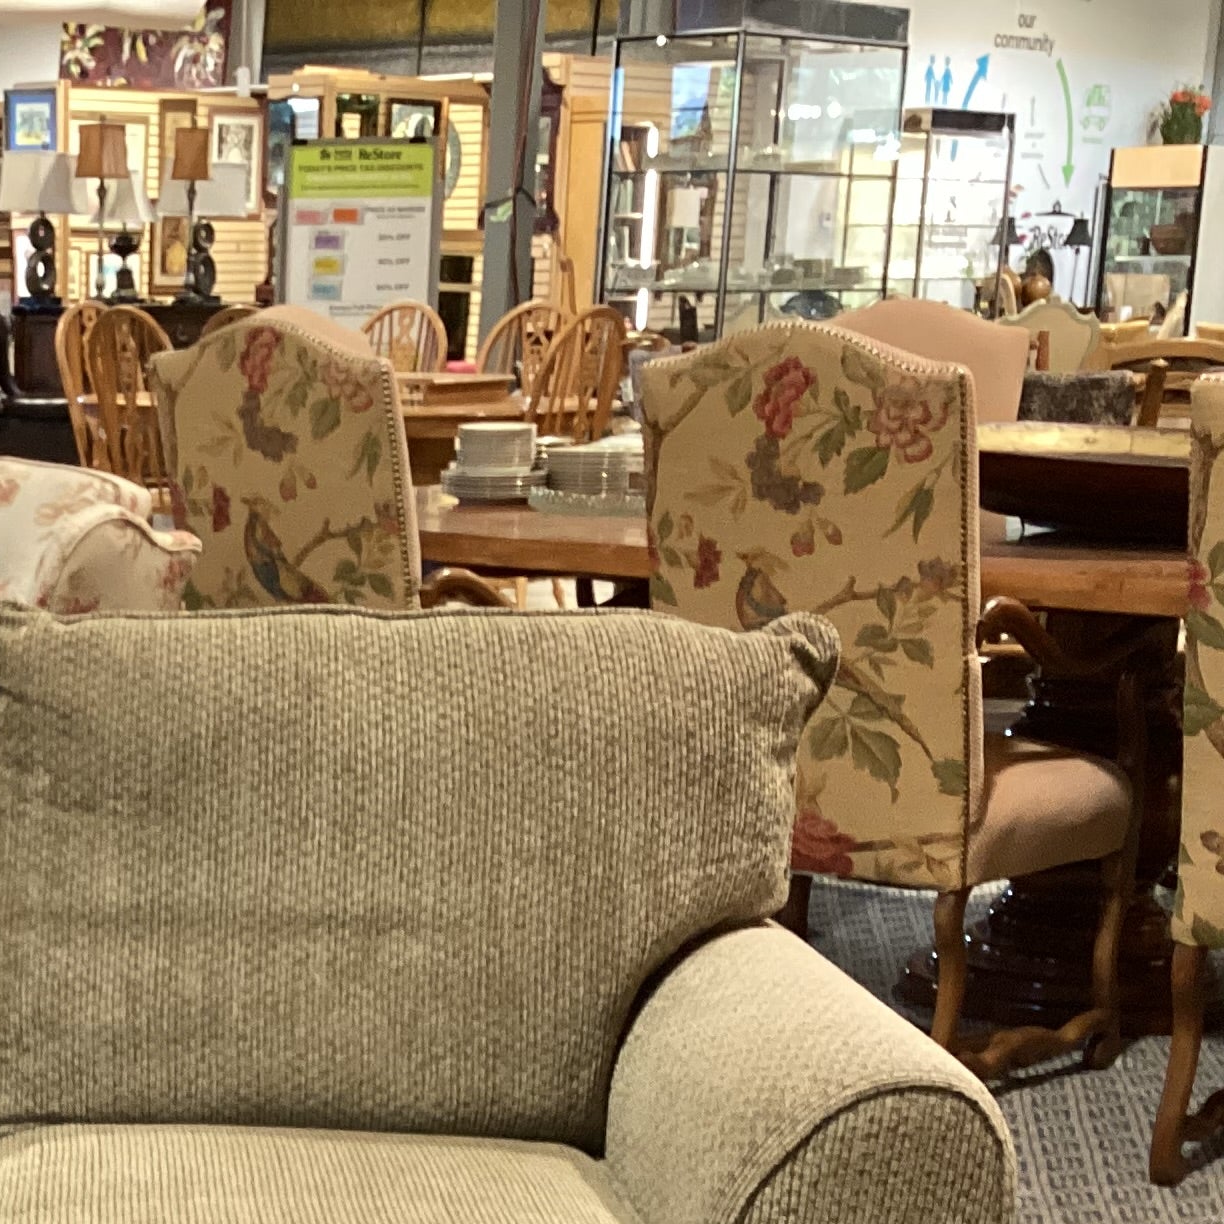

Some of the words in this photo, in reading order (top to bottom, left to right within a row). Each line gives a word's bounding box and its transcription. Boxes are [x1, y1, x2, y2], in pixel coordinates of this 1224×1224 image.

[1018, 13, 1037, 29] our
[994, 32, 1056, 58] community
[358, 148, 403, 160] ReStore
